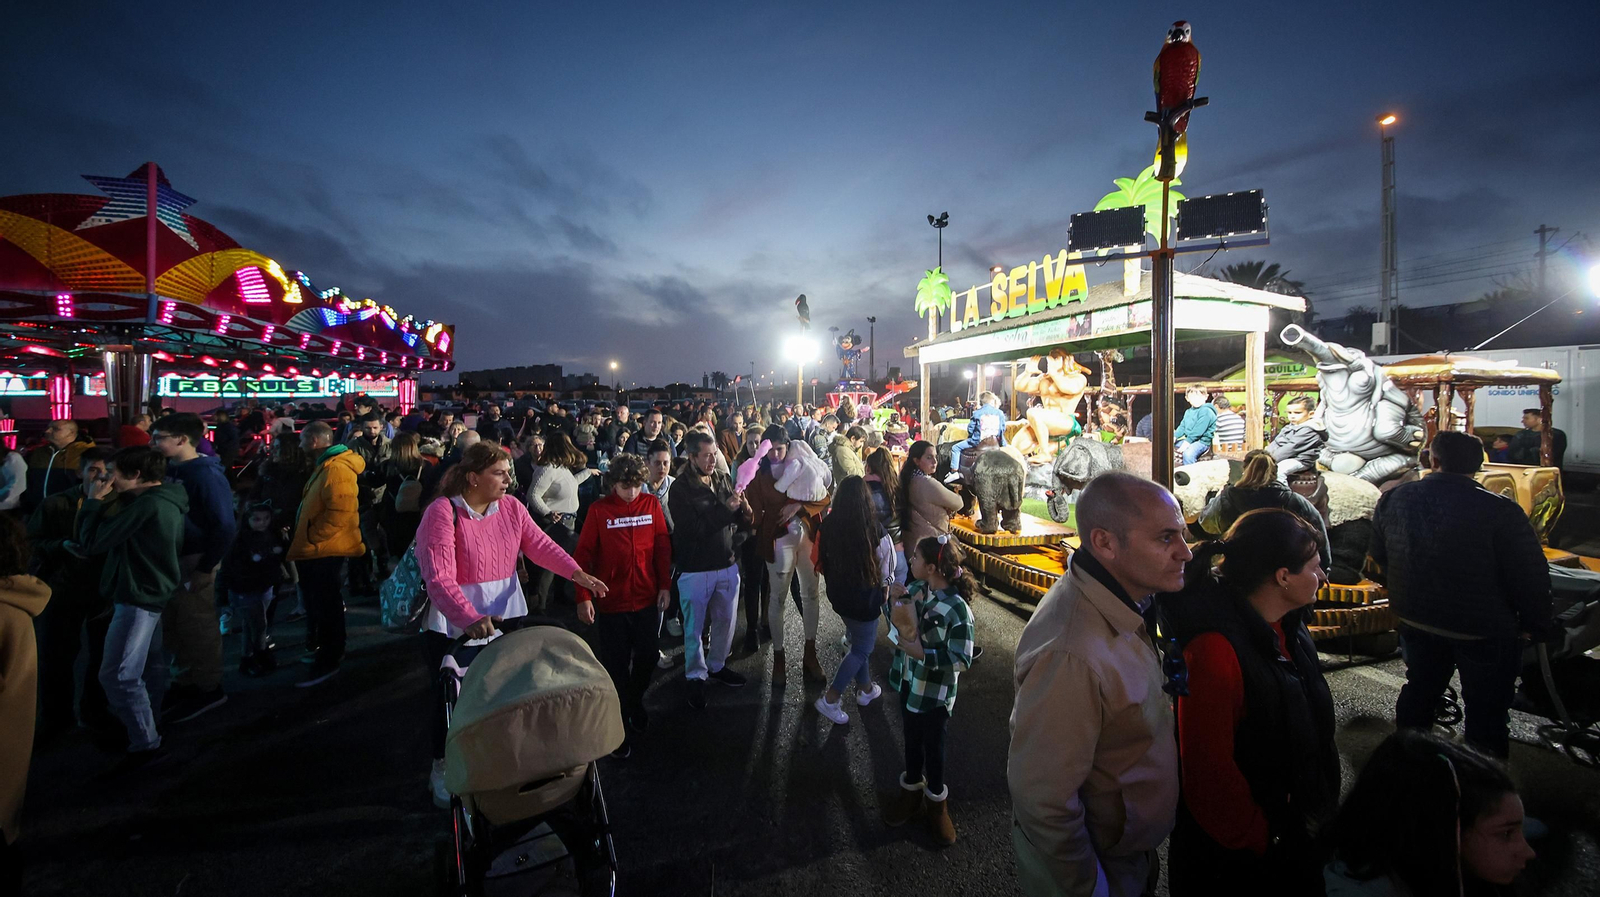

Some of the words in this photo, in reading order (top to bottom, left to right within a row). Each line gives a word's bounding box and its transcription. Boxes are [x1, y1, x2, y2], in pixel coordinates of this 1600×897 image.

[951, 285, 980, 333] LA
[991, 249, 1089, 322] SELVA
[1264, 363, 1306, 374] AQUILLA
